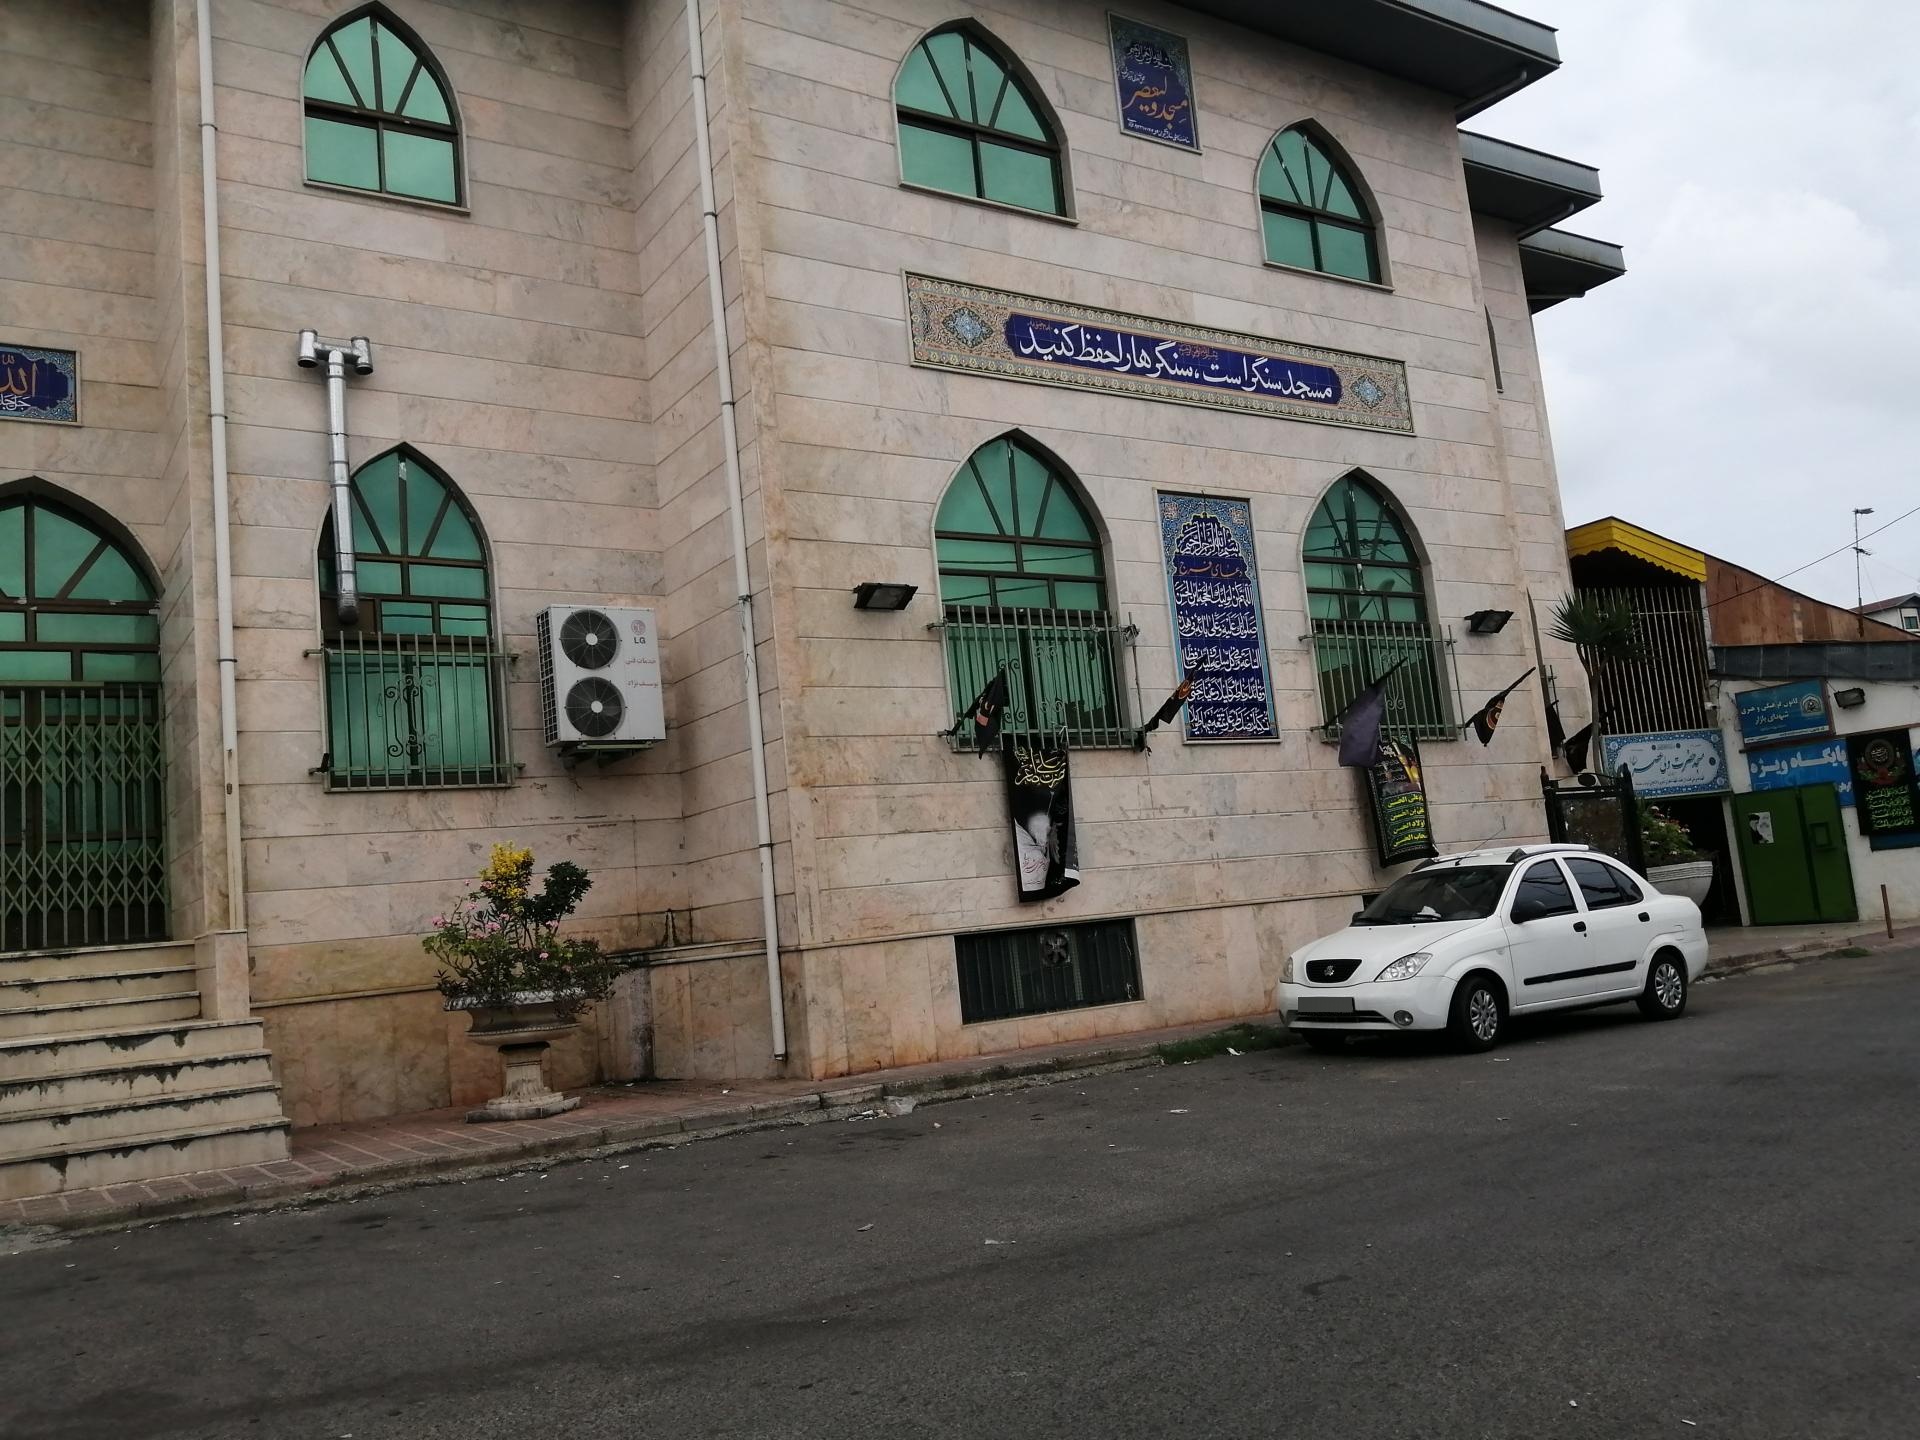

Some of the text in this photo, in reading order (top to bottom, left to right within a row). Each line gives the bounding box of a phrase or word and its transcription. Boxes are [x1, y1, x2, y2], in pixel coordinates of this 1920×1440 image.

[1019, 324, 1080, 361] کنید
[1073, 327, 1120, 364] حفظ
[1113, 333, 1132, 372] را
[1241, 357, 1284, 392] سنگر
[1281, 370, 1333, 400] مسجد
[1761, 701, 1782, 712] فرهنگی
[1750, 757, 1789, 778] ویژه
[1790, 745, 1848, 768] پایگاه
